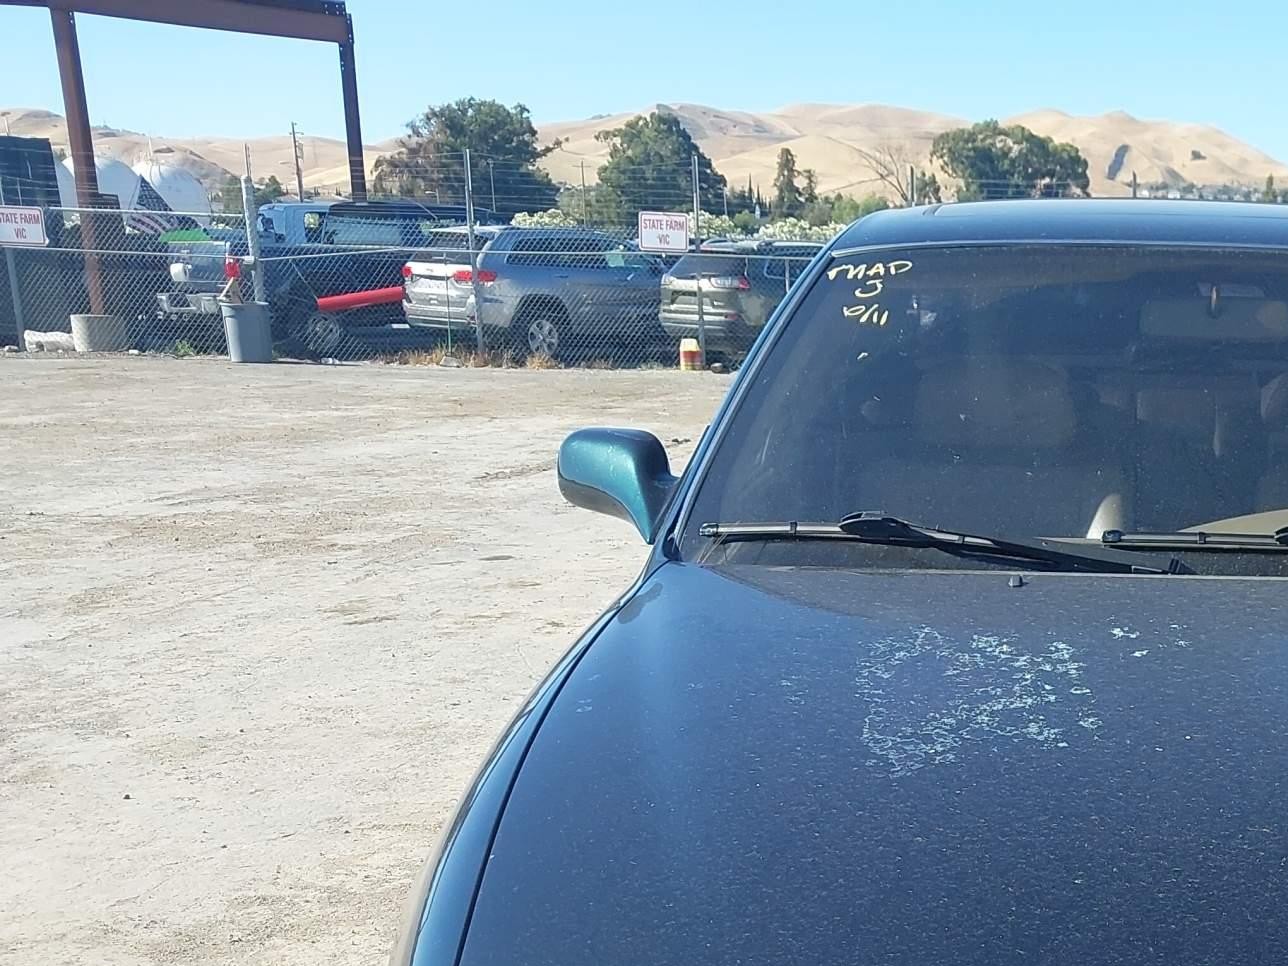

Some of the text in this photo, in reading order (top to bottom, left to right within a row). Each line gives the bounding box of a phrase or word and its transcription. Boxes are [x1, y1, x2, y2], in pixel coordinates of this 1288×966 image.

[20, 213, 40, 225] FARM
[643, 219, 685, 231] STATE FARM
[14, 227, 27, 239] VIC
[658, 234, 670, 245] VIC
